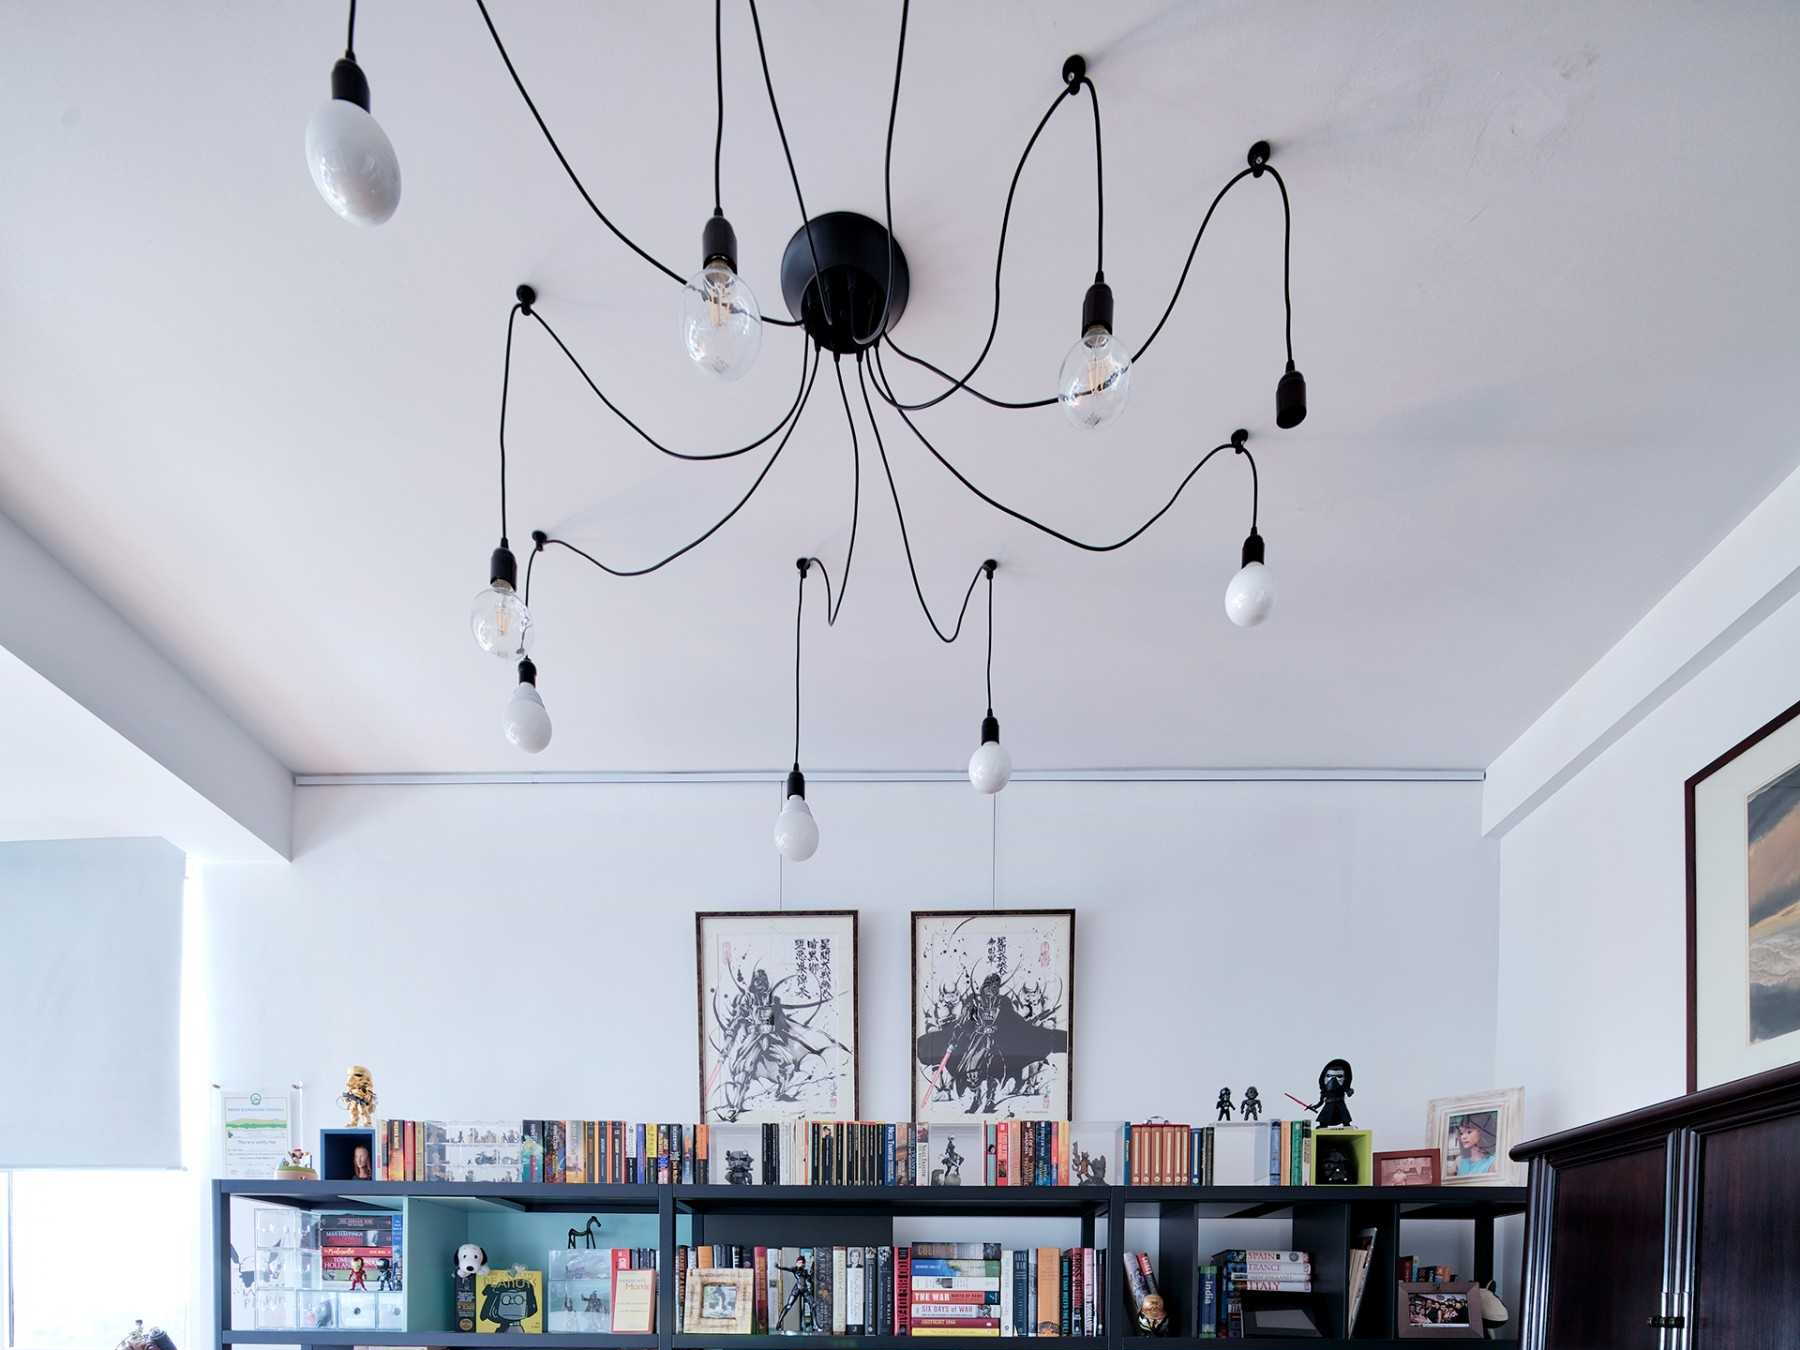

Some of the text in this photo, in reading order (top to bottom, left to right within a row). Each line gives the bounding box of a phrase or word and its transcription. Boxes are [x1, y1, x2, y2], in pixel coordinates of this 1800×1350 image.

[1248, 1282, 1280, 1291] ITALY
[1204, 1280, 1212, 1304] India
[914, 1293, 931, 1301] THE
[933, 1293, 950, 1301] WAR
